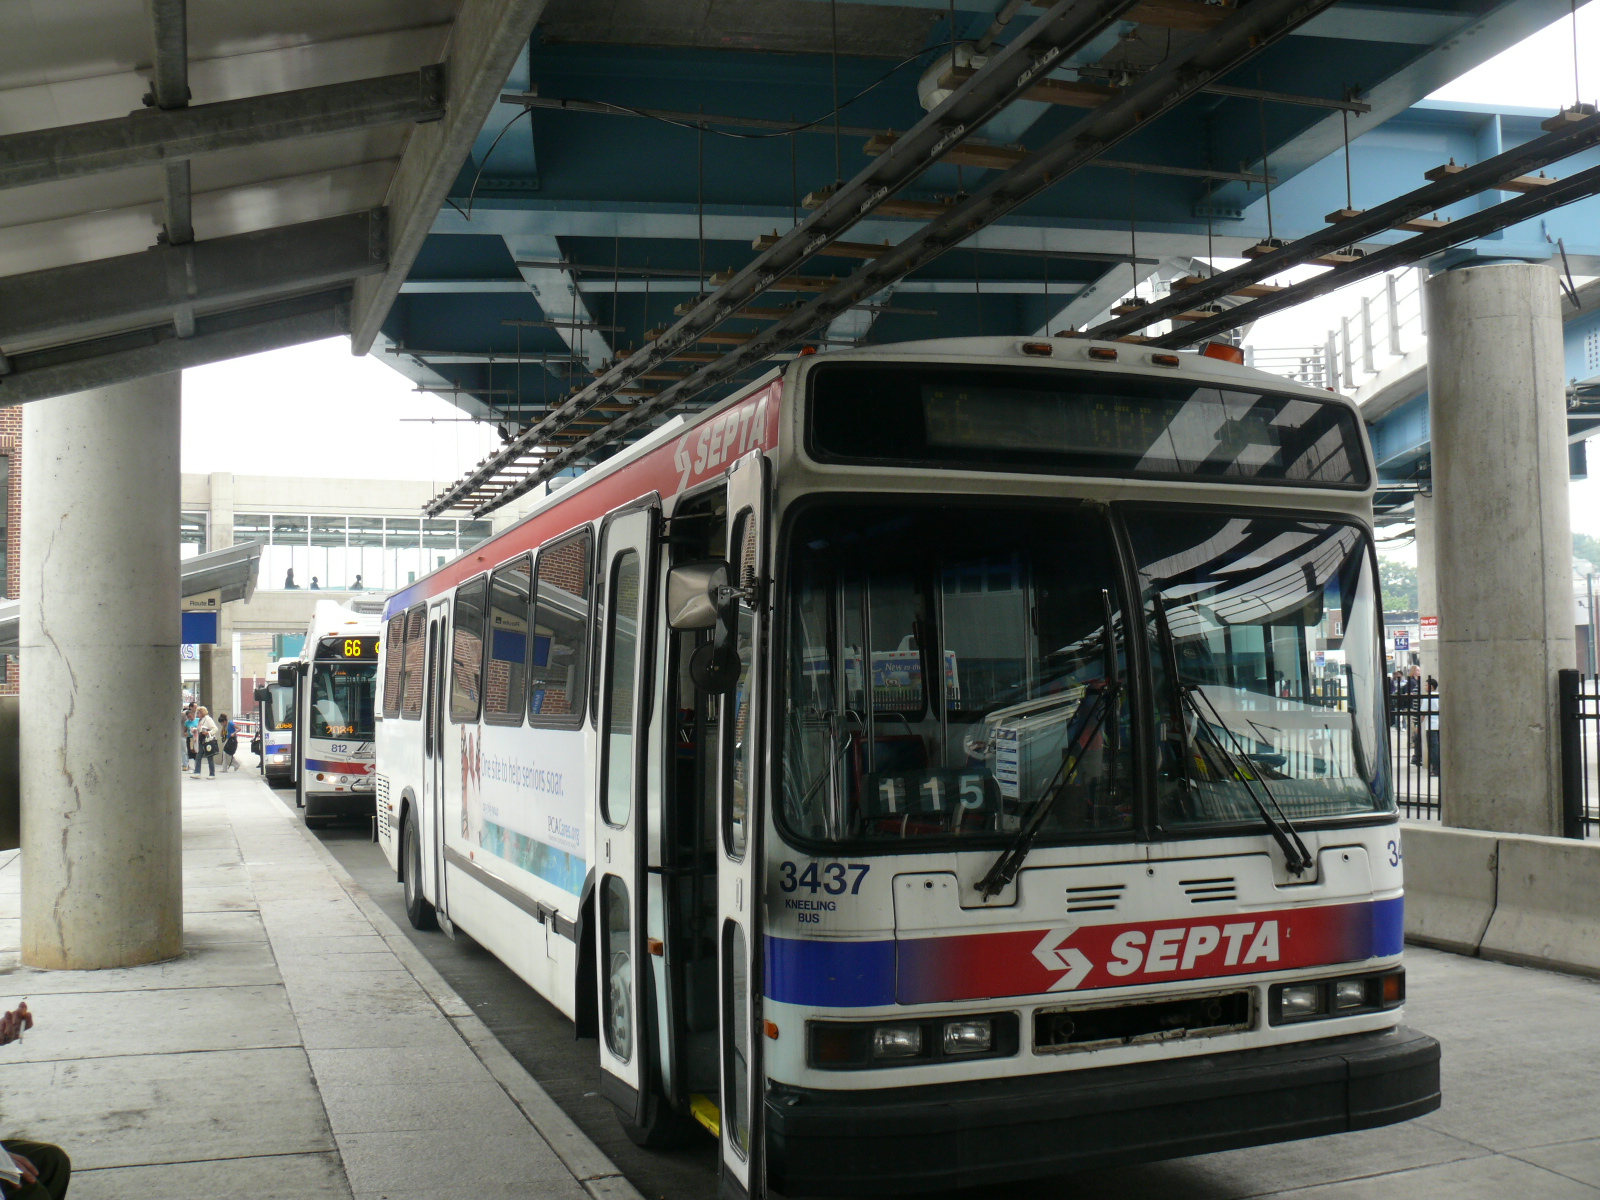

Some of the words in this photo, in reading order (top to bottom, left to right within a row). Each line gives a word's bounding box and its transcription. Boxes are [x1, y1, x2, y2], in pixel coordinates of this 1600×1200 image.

[694, 395, 768, 475] SEPTA
[344, 639, 361, 657] 66
[885, 662, 902, 671] New
[325, 725, 354, 734] 2084
[331, 744, 348, 753] 812
[481, 752, 491, 779] One
[491, 753, 501, 781] site
[502, 757, 508, 783] to
[509, 756, 521, 792] help
[522, 760, 546, 792] seniors
[547, 770, 564, 797] soar.
[879, 775, 984, 813] 115
[547, 815, 580, 847] PCACares.org
[780, 861, 870, 895] 3437
[785, 900, 836, 911] KNEELING
[798, 912, 820, 923] BUS
[1106, 920, 1280, 977] SEPTA
